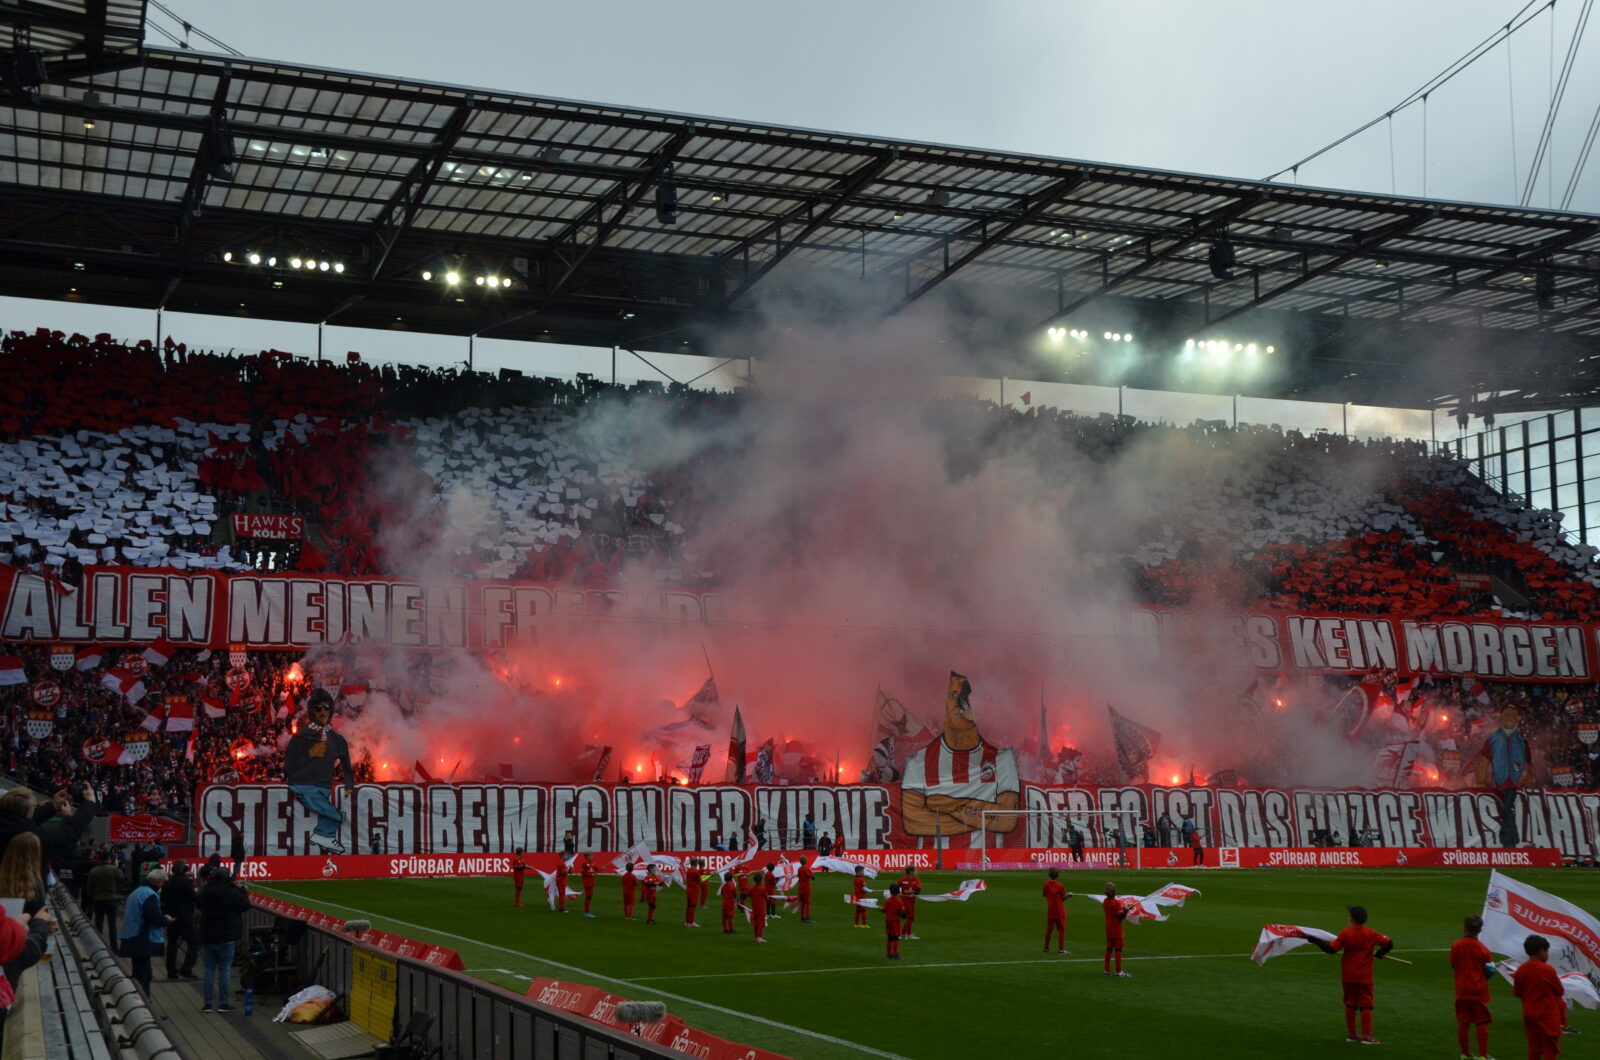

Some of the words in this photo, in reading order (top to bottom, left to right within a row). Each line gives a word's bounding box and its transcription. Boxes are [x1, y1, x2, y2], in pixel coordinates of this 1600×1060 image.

[234, 514, 301, 534] HAWKS
[252, 529, 286, 539] KÖLN
[2, 570, 216, 644] ALLEN
[228, 578, 468, 649] MEINEN
[1287, 615, 1398, 672] KEIN
[1401, 619, 1590, 679] MORGEN
[428, 784, 548, 853] BEIM
[552, 785, 612, 852] FC
[614, 786, 665, 852] IN
[669, 786, 755, 851] DER
[755, 786, 892, 851] KURVE
[1026, 785, 1098, 848] DER
[1152, 787, 1214, 848] IST
[1217, 788, 1294, 848] DAS
[1425, 791, 1502, 848] WAS
[1508, 787, 1600, 858] ÄHLT
[390, 856, 454, 874] SPÜRBAR
[457, 857, 514, 873] ANDERS.
[884, 853, 932, 868] ANDERS.
[1269, 849, 1318, 865] SPÜRBAR
[1319, 851, 1363, 865] ANDERS.
[1442, 849, 1489, 865] SPÜRBAR
[1491, 851, 1533, 865] ANDERS.
[538, 986, 582, 1011] DERTOUR
